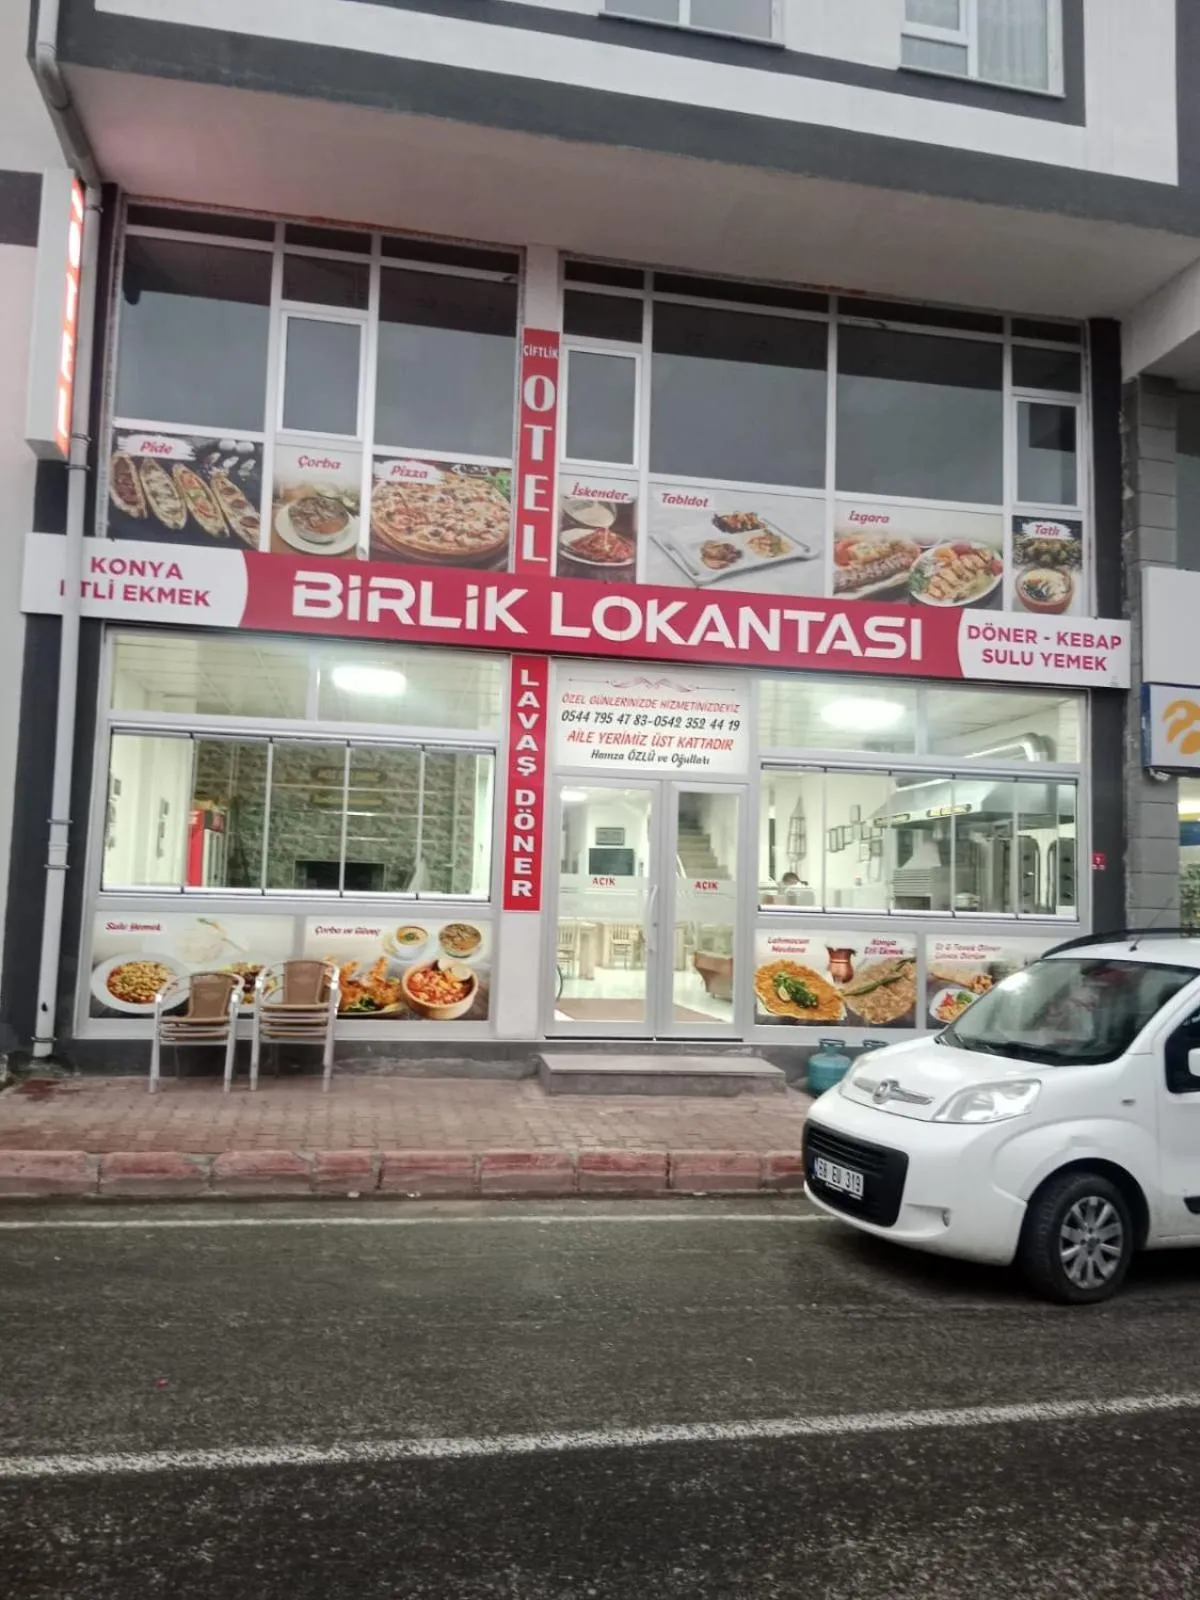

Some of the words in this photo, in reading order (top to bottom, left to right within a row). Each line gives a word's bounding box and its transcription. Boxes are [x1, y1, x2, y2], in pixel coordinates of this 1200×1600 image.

[523, 344, 559, 359] ÇİFTLİK
[140, 439, 174, 455] Pide
[297, 454, 341, 470] Çorba
[522, 374, 556, 562] OTEL
[391, 463, 428, 479] Pizza
[571, 482, 629, 501] İskender
[661, 492, 709, 508] Tabldot
[848, 510, 890, 525] Izgara
[1034, 524, 1060, 537] Tatlı
[90, 556, 184, 580] KONYA
[60, 579, 114, 600] TLİ
[122, 584, 211, 607] EKMEK
[292, 570, 529, 634] BİRLİK
[550, 591, 923, 661] LOKANTASI
[967, 622, 1037, 645] DÖNER
[1056, 631, 1122, 650] KEBAP
[982, 648, 1034, 666] SULU
[1040, 653, 1107, 671] YEMEK
[562, 692, 586, 705] ÖZEL
[515, 669, 541, 777] LAVAŞ
[561, 710, 590, 722] 0544
[594, 712, 613, 724] 795
[616, 713, 632, 726] 47
[633, 715, 681, 729] 83-0542
[685, 717, 706, 730] 352
[709, 719, 724, 730] 44
[728, 720, 740, 731] 19
[567, 730, 593, 743] AİLE
[599, 731, 647, 748] YERİMİZ
[651, 733, 674, 748] ÜST
[676, 736, 734, 751] KATTADIR
[590, 749, 625, 761] Hamza
[627, 749, 655, 762] ÖZLÜ
[657, 754, 668, 763] ve
[511, 788, 536, 897] DÖNER
[592, 877, 616, 887] AÇIK
[694, 880, 719, 890] AÇIK
